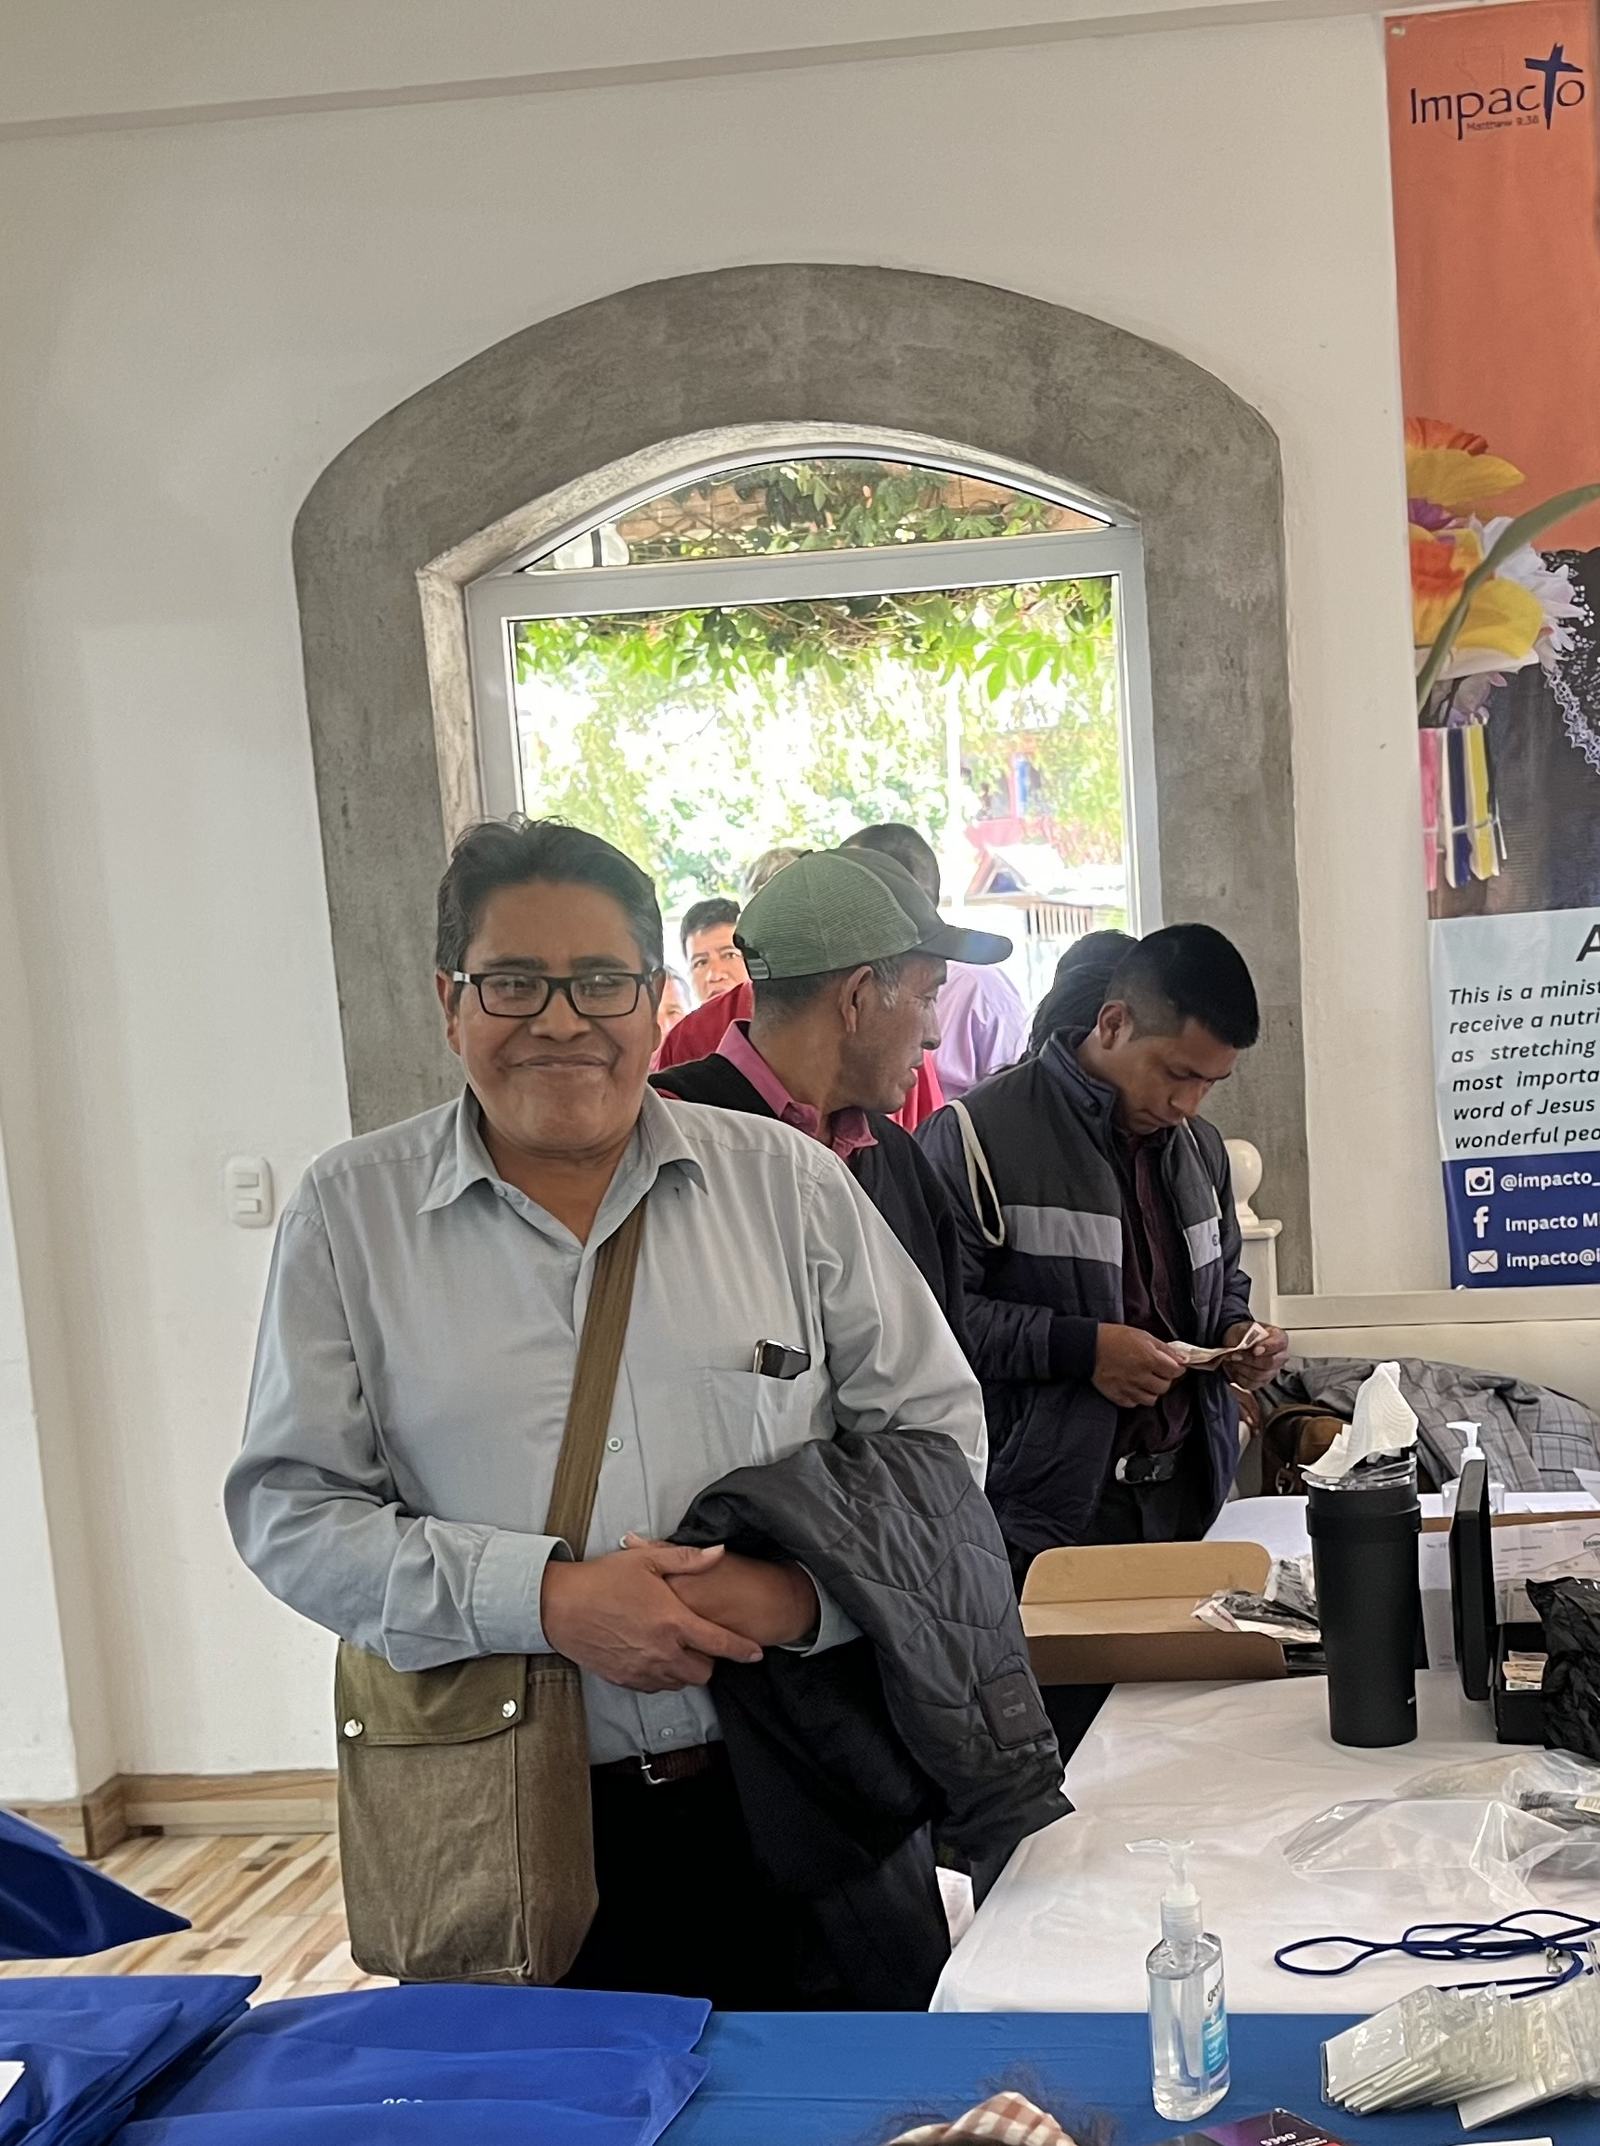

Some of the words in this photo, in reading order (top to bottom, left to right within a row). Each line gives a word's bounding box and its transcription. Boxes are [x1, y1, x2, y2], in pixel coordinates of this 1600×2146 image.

[1410, 43, 1585, 140] Impacto
[1449, 986, 1490, 1005] This
[1497, 985, 1513, 1001] is
[1520, 987, 1533, 1000] a
[1450, 1014, 1524, 1034] receive
[1531, 1015, 1544, 1028] a
[1550, 1007, 1600, 1027] nutri
[1451, 1049, 1474, 1063] as
[1490, 1038, 1596, 1060] stretching
[1453, 1074, 1503, 1092] most
[1516, 1069, 1600, 1090] importa
[1454, 1100, 1504, 1120] word
[1511, 1098, 1533, 1116] of
[1536, 1098, 1595, 1115] Jesus
[1455, 1126, 1559, 1149] wonderful
[1564, 1127, 1600, 1147] peo
[1505, 1215, 1578, 1234] Impacto
[1582, 1211, 1600, 1227] M
